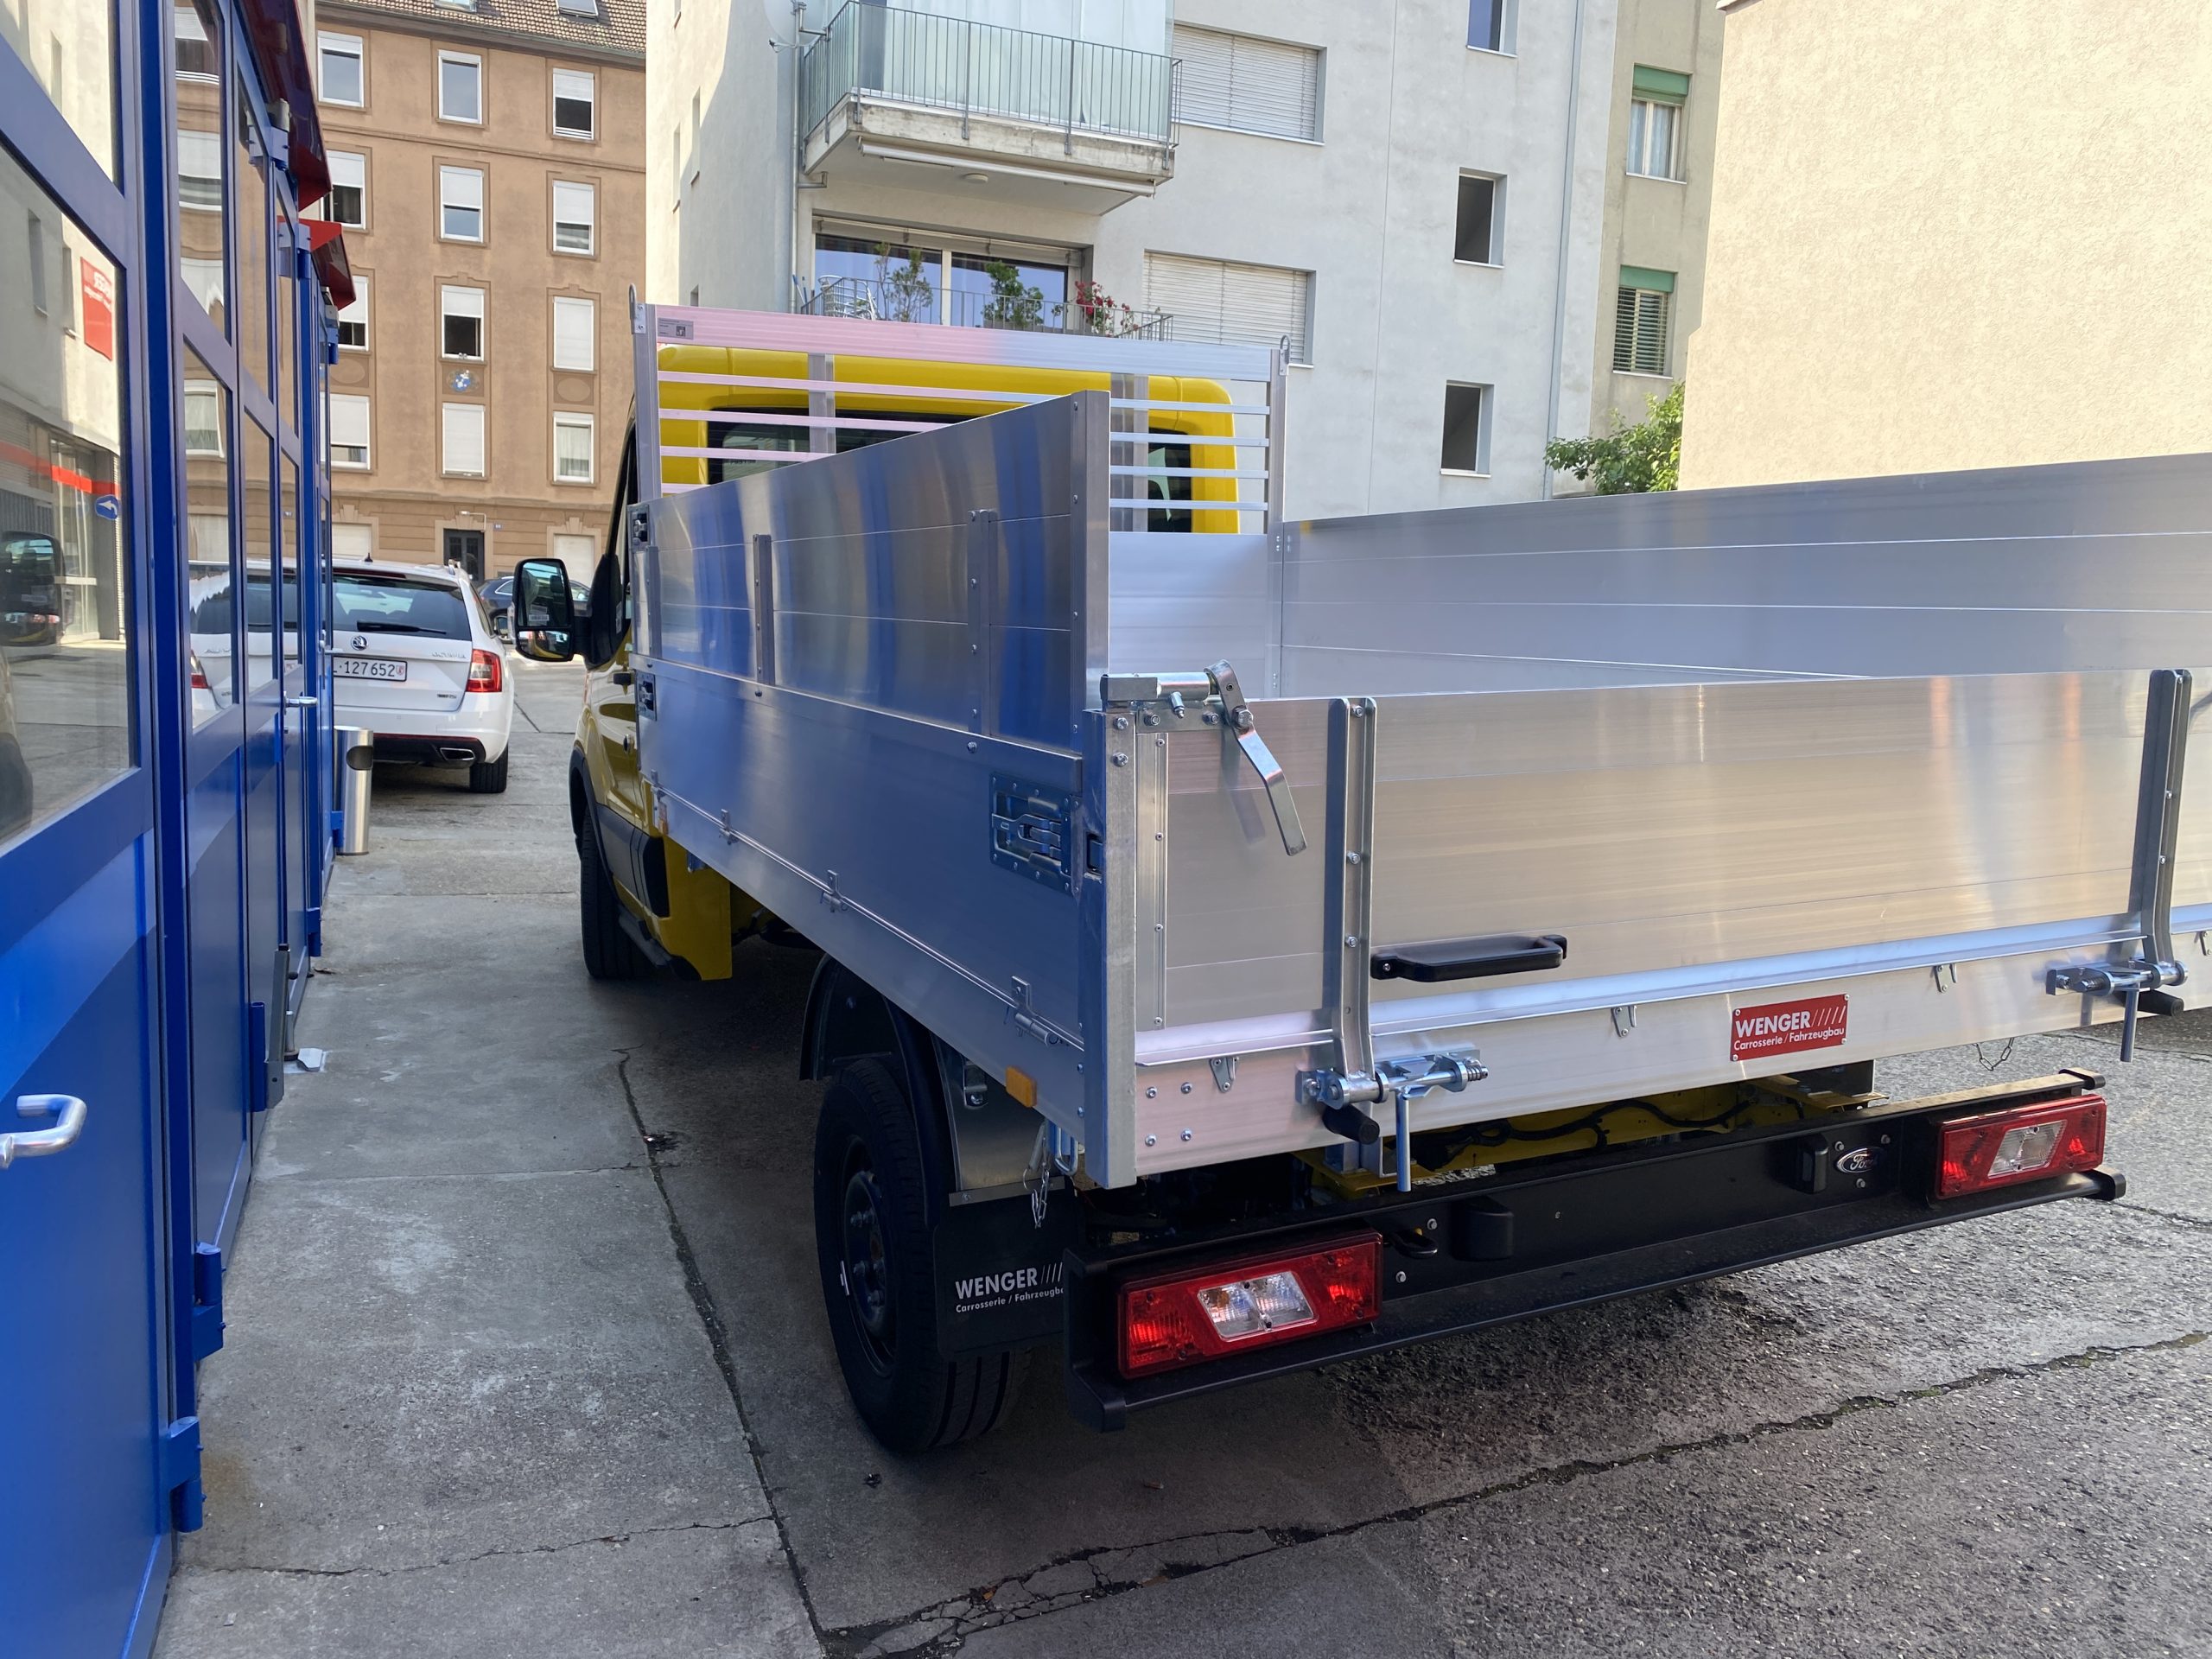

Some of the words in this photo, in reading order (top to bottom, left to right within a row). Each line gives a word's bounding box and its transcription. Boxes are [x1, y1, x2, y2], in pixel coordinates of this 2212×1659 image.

[1735, 1011, 1811, 1038] WENGER
[1733, 1035, 1783, 1051] Carrosserie
[1789, 1027, 1845, 1043] Fahrzeugbau
[1850, 1154, 1877, 1170] For
[955, 1268, 1038, 1299] WENGER
[956, 1296, 1007, 1313] Carrosserie
